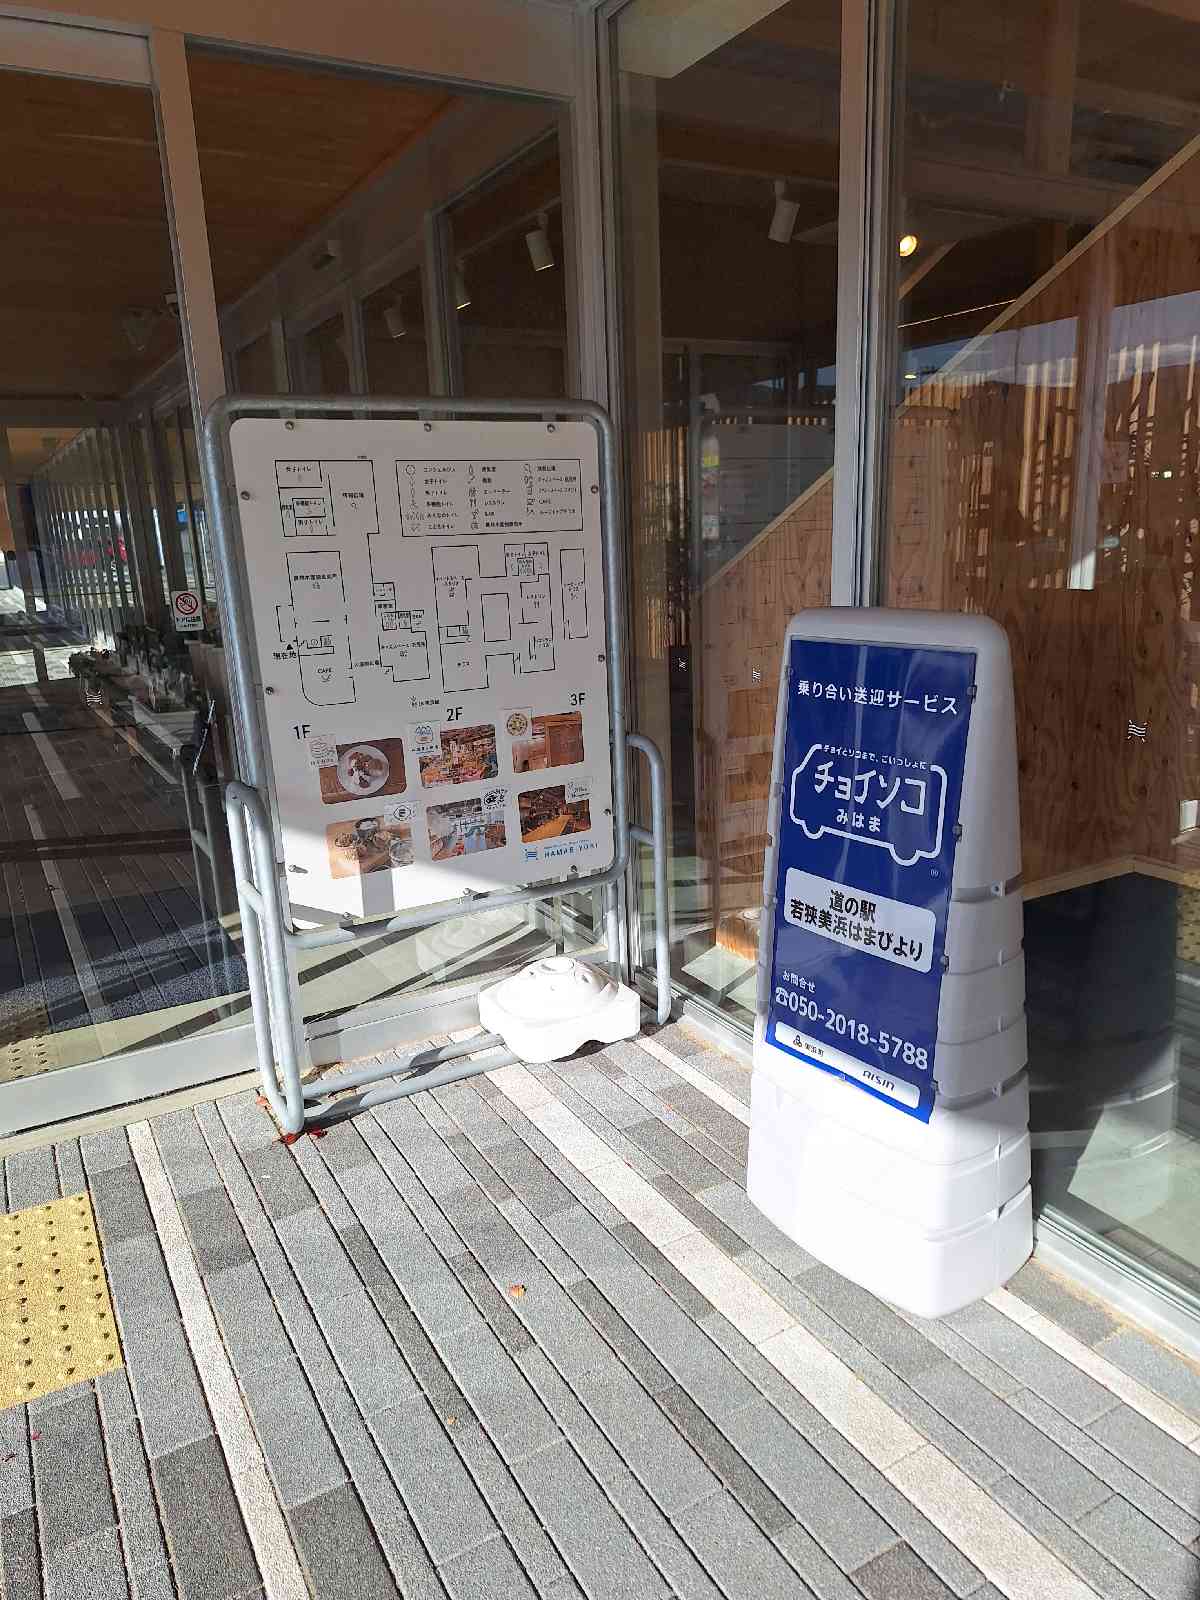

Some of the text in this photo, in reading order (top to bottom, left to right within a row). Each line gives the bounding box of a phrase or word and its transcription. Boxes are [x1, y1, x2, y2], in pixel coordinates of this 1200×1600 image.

[570, 692, 585, 706] 3F
[798, 679, 958, 715] 乗り合い送迎サービス
[446, 707, 463, 722] 2F
[293, 724, 311, 740] 1F
[814, 760, 927, 816] チョイソコ
[836, 808, 881, 832] みはま
[829, 889, 877, 923] 道の駅
[790, 897, 923, 962] 若狭美浜はまびより
[782, 969, 816, 994] お問合せ
[787, 991, 929, 1070] 050-2018-5788
